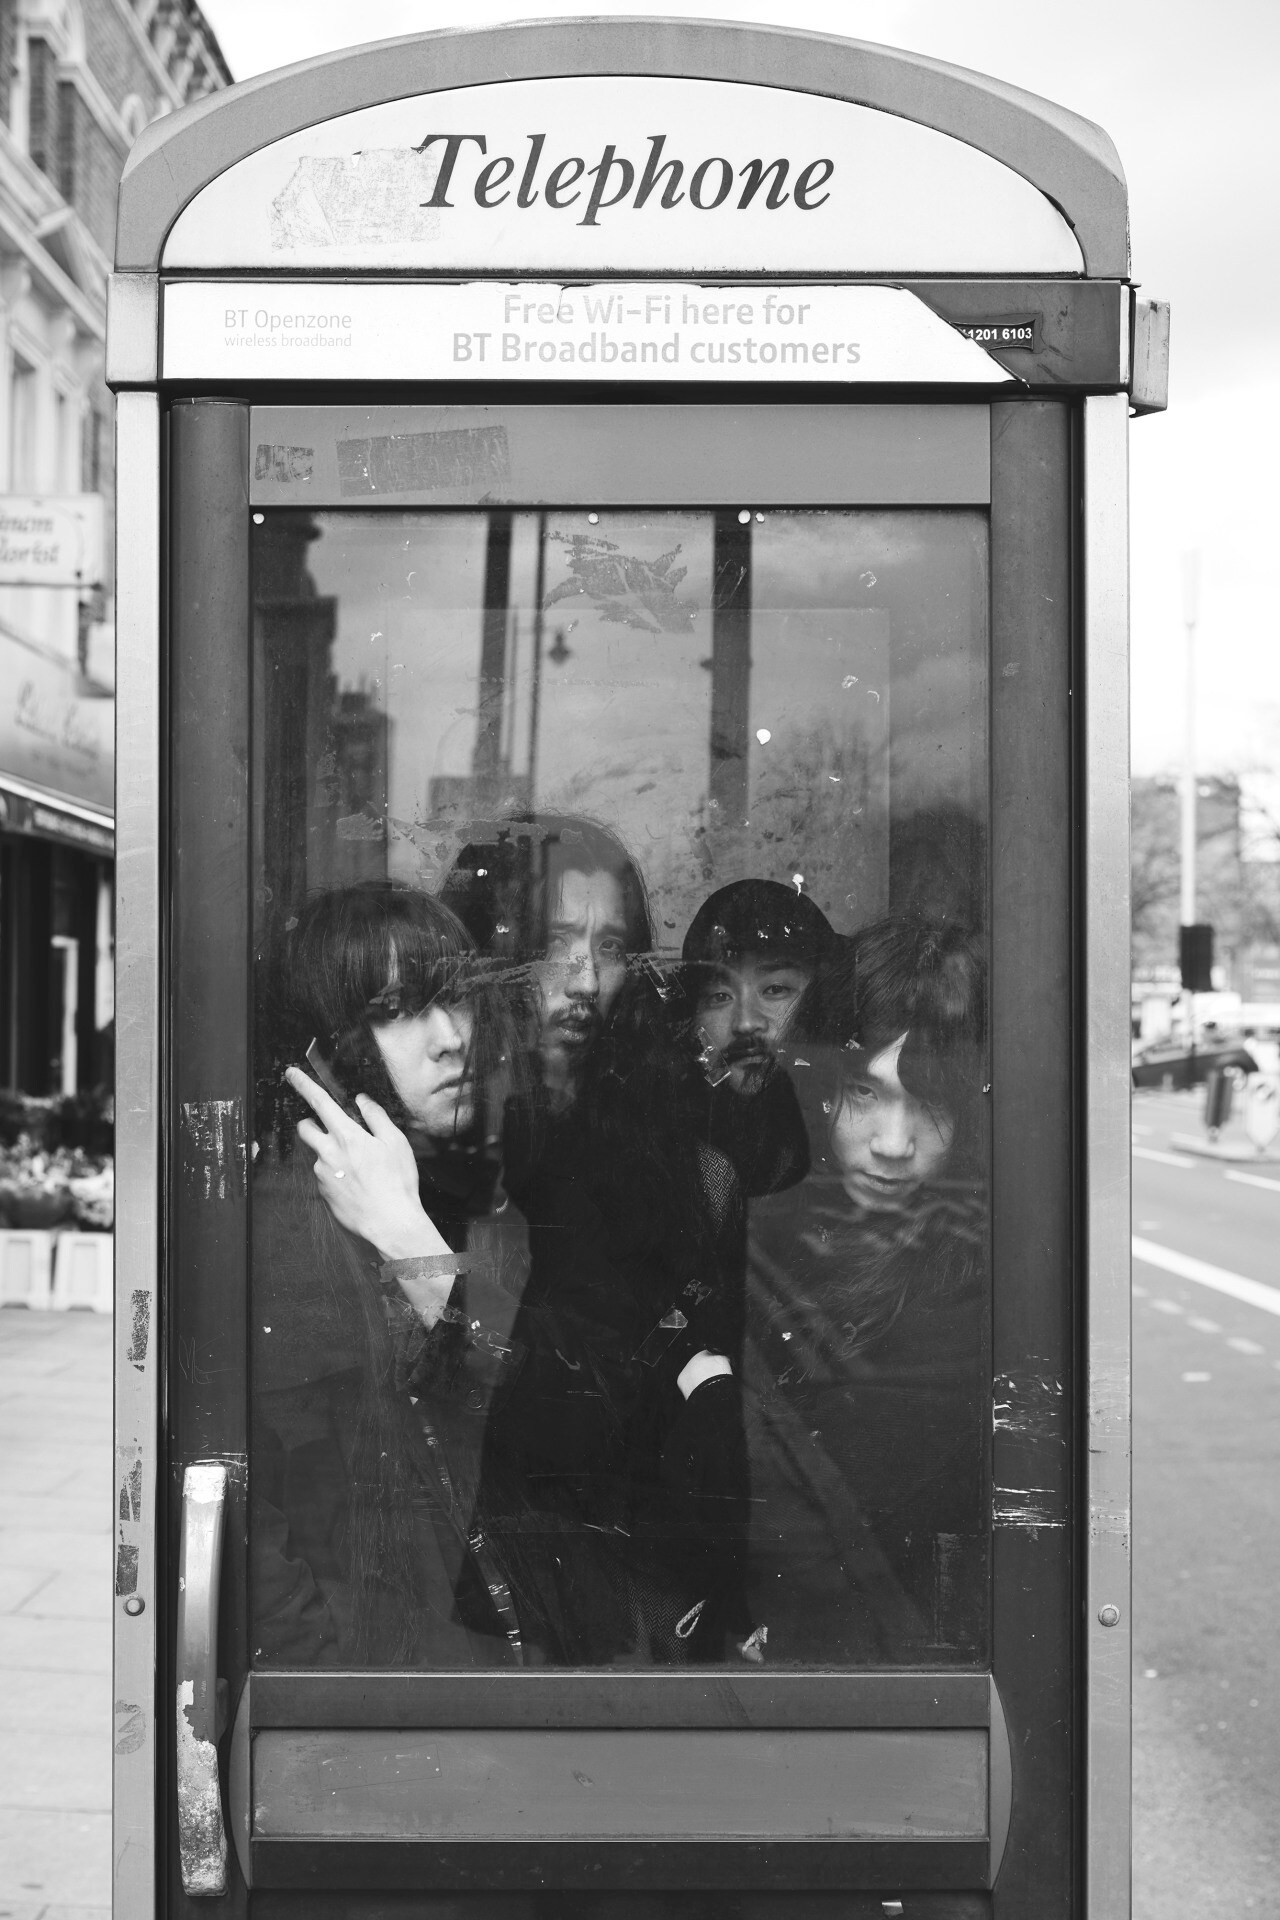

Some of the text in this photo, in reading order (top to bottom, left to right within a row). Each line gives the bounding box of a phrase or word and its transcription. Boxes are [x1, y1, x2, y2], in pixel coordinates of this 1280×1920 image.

[419, 133, 835, 227] Telephone
[224, 309, 353, 333] BT Openzone
[503, 293, 812, 325] Free Wi-Fi here for
[224, 332, 353, 348] wireless broadband
[452, 331, 862, 365] BT Broadband customers
[962, 326, 1034, 342] 1201 6103
